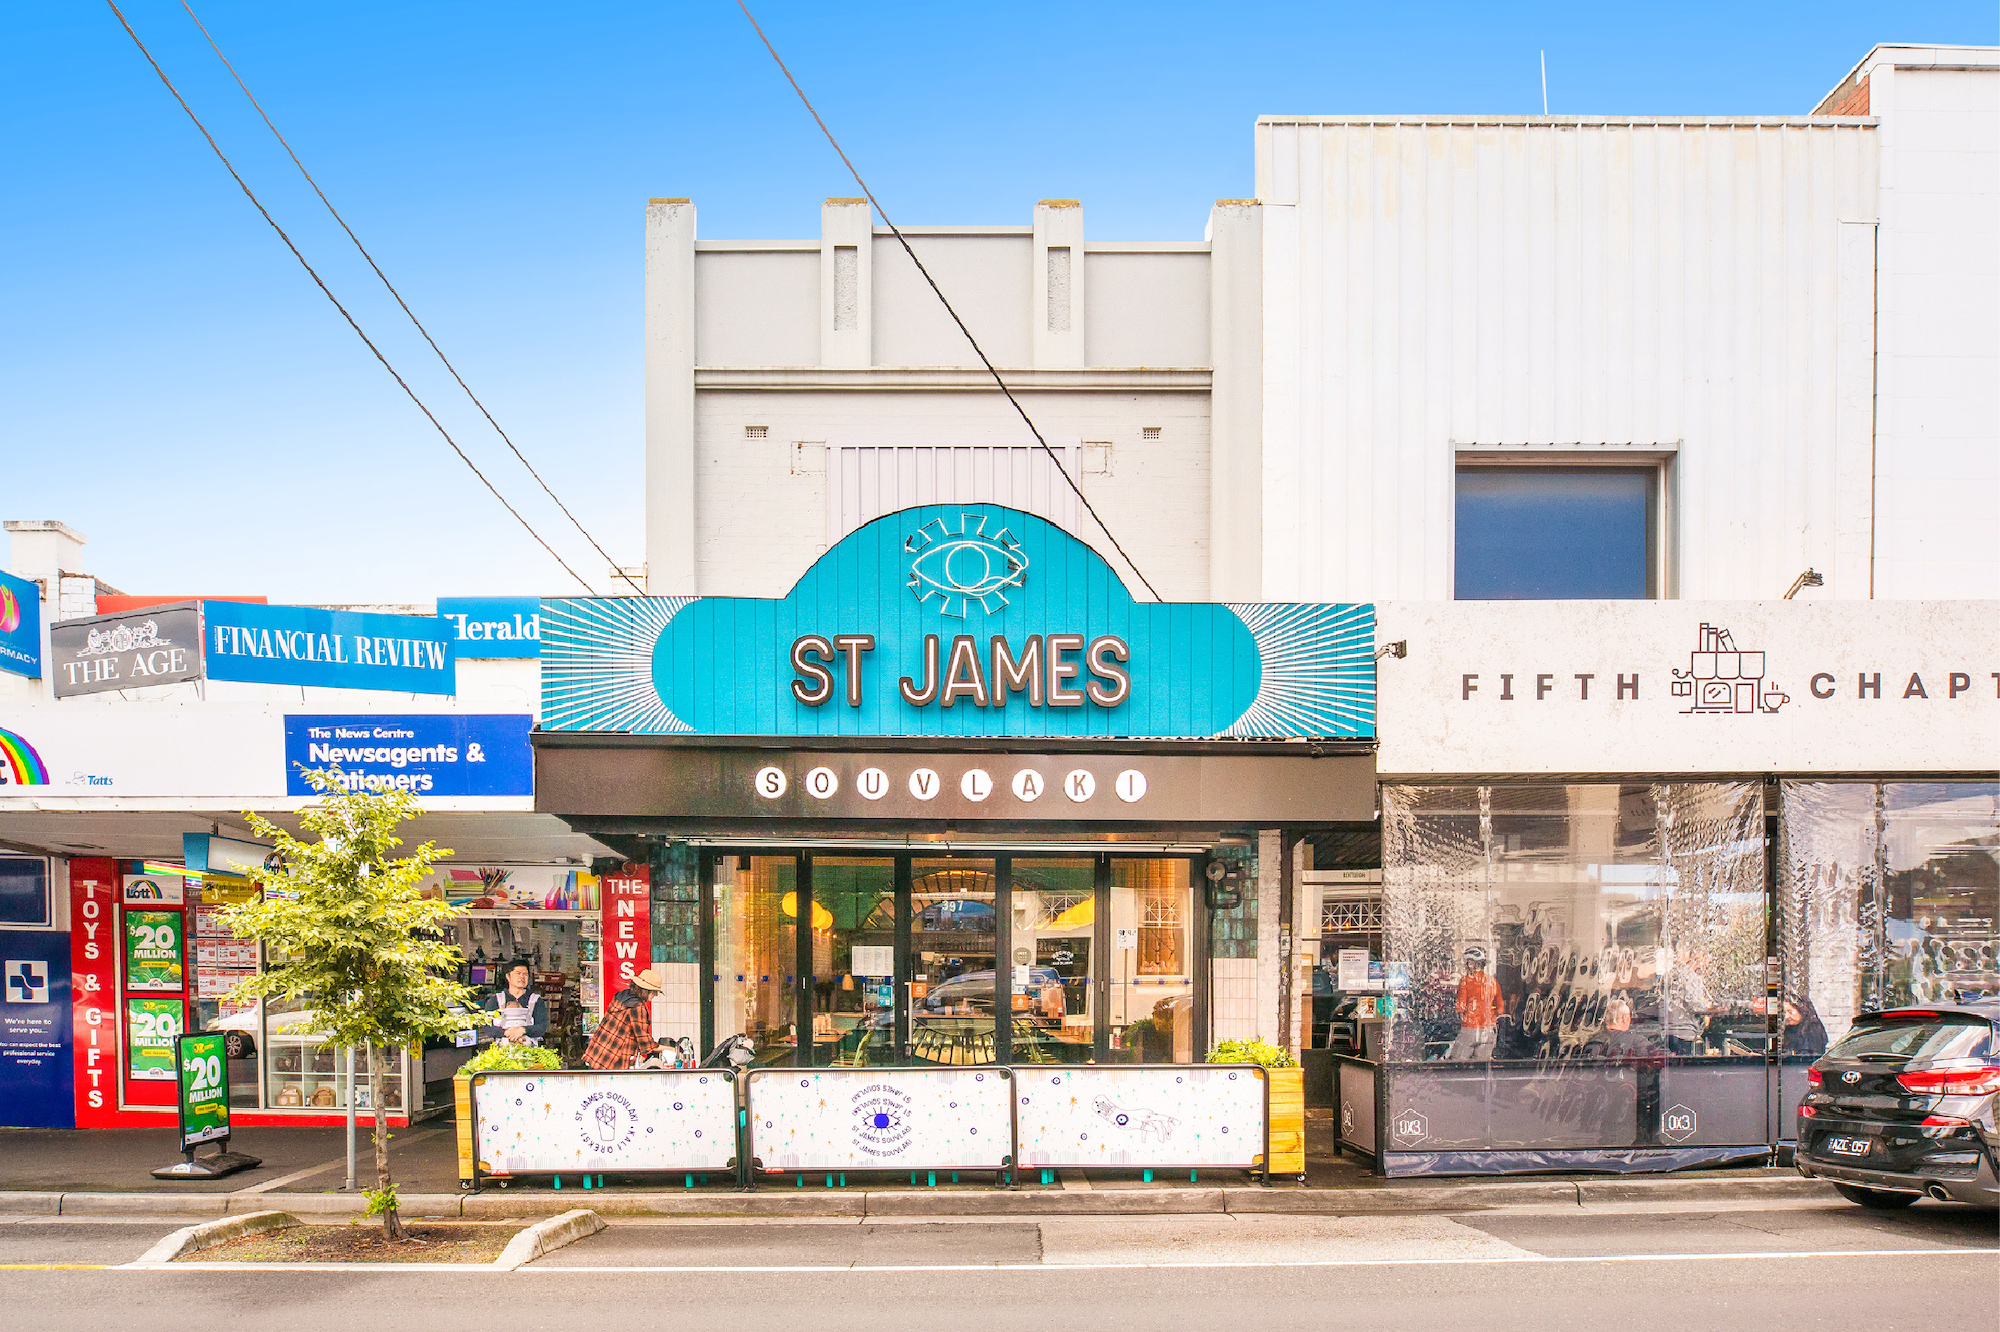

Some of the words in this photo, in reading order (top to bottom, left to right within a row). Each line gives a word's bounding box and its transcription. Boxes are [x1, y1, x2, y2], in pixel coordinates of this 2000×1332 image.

[443, 613, 541, 640] Herald
[214, 625, 348, 663] FINANCIAL
[354, 635, 447, 670] REVIEW
[63, 657, 120, 684] THE
[130, 648, 187, 677] AGE
[791, 634, 875, 707] ST
[899, 634, 1131, 707] JAMES
[1462, 673, 1639, 700] FIFTH
[309, 728, 331, 738] The
[335, 728, 370, 738] News
[373, 728, 414, 738] Centre
[309, 743, 457, 768] Newsagents
[466, 742, 485, 762] &
[87, 775, 113, 785] Tatts
[311, 769, 433, 790] Sationers
[763, 771, 1136, 797] SOUVLAKI
[607, 879, 642, 894] THE
[941, 900, 963, 912] 397
[83, 880, 99, 959] TOYS
[130, 925, 175, 949] $20
[615, 900, 638, 979] NEWS
[134, 950, 177, 959] MILLION
[84, 974, 101, 991] &
[135, 1037, 175, 1046] MILLION
[85, 1007, 103, 1108] GIFTS
[183, 1055, 221, 1091] $20
[189, 1087, 222, 1103] MILLION
[575, 1110, 583, 1121] ST
[581, 1092, 603, 1110] JAMES
[606, 1091, 638, 1121] SOUVLAKI
